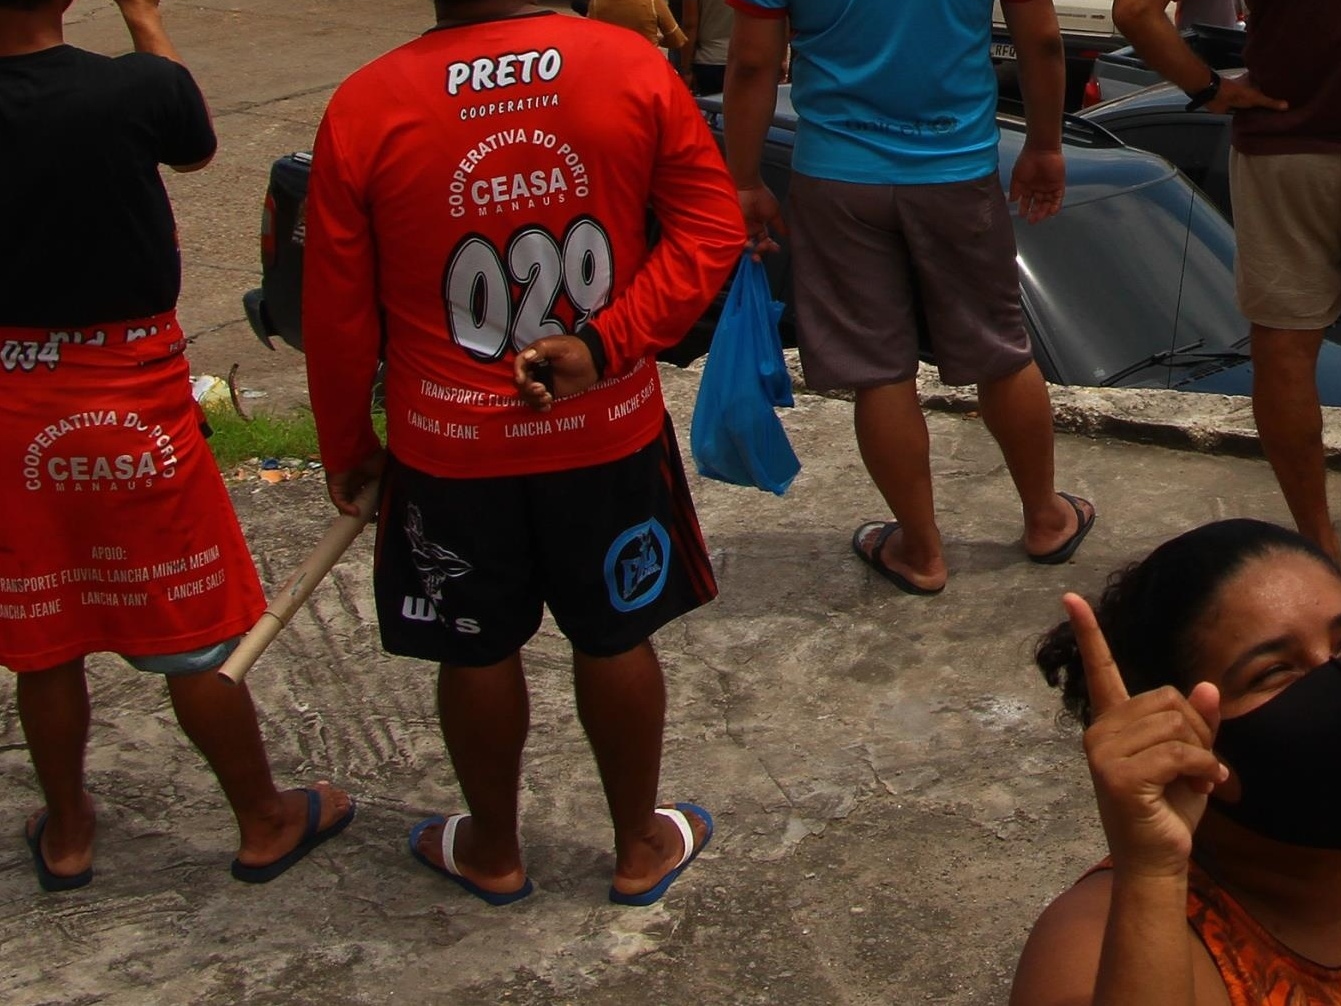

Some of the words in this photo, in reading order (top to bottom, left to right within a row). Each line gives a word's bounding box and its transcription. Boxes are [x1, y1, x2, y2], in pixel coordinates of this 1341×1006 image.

[446, 47, 562, 95] PRETO
[460, 94, 559, 120] COOPERATIVA
[449, 128, 527, 217] COOPERATIVA
[532, 129, 556, 148] DO
[557, 143, 589, 197] PORTO
[471, 167, 568, 205] CEASA
[478, 193, 566, 217] MANAUS
[443, 218, 614, 360] 029
[421, 379, 486, 406] TRANSPORTE
[407, 410, 440, 434] LANCHA
[443, 422, 479, 439] JEANE
[505, 419, 552, 438] LANCHA
[555, 415, 586, 432] YANY
[608, 394, 640, 422] LANCHE
[23, 411, 117, 490] COOPERATIVA
[148, 425, 178, 479] PORTO
[47, 452, 157, 481] CEASA
[55, 479, 153, 492] MANAUS
[0, 573, 58, 592] RANSPORTE
[61, 567, 103, 584] FLUVIAL
[107, 567, 149, 583] LANCHA
[152, 563, 187, 579] MINHA
[189, 545, 220, 570] MENINA
[92, 546, 128, 560] APOIO:
[0, 604, 26, 620] ANCHA
[29, 598, 62, 618] JEANE
[81, 591, 119, 606] LANCHA
[122, 593, 148, 606] YANY
[167, 582, 204, 601] LANCHE
